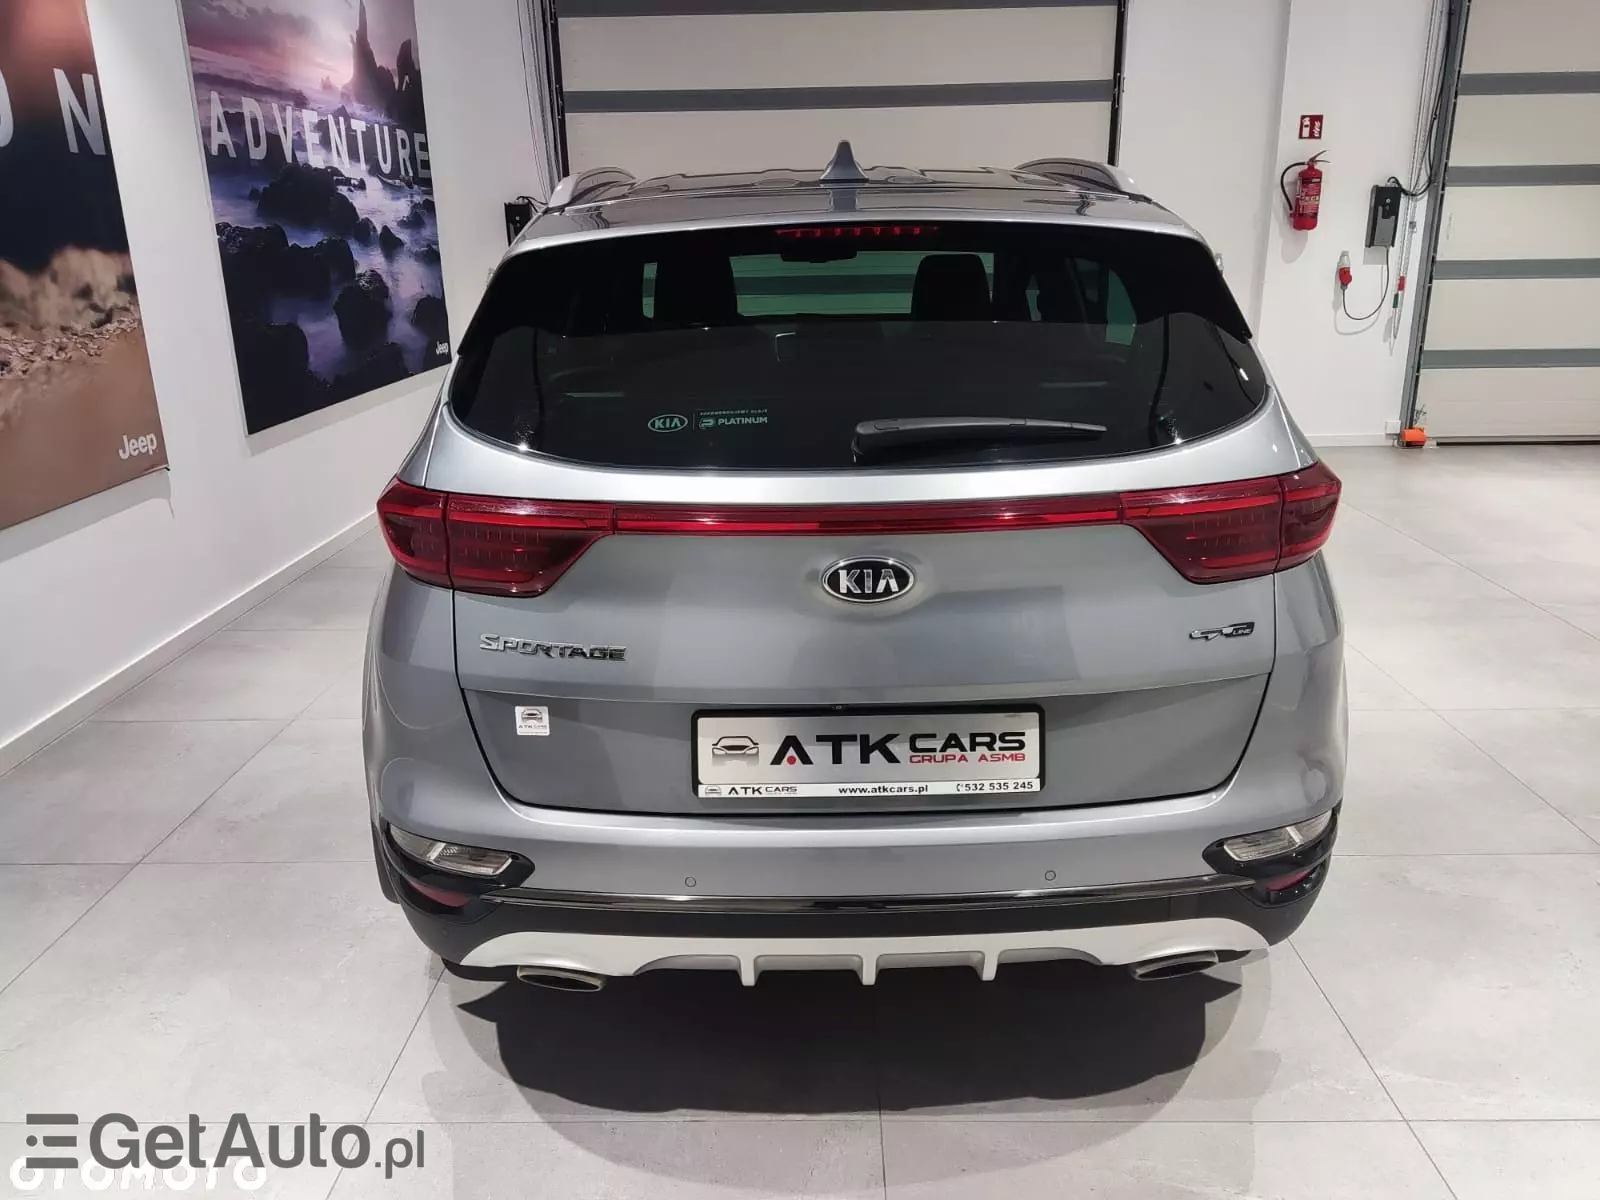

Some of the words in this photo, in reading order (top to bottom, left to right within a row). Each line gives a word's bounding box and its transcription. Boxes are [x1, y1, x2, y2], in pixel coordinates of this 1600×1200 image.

[209, 90, 431, 179] ADVENTURE
[436, 340, 449, 356] Jeep
[654, 417, 681, 429] KIA
[718, 416, 768, 426] PLATINUM
[118, 431, 157, 460] Jeep
[838, 568, 899, 594] KIA
[479, 633, 627, 661] SPORTAGE
[770, 733, 901, 766] ATK
[909, 731, 1026, 752] CARS
[909, 753, 968, 764] GRUPA
[978, 752, 1026, 762] ASMB
[728, 786, 762, 796] ATK
[838, 783, 928, 795] www.atkcars.pl
[964, 783, 985, 792] 532
[988, 782, 1009, 791] 535
[1013, 781, 1033, 790] 245
